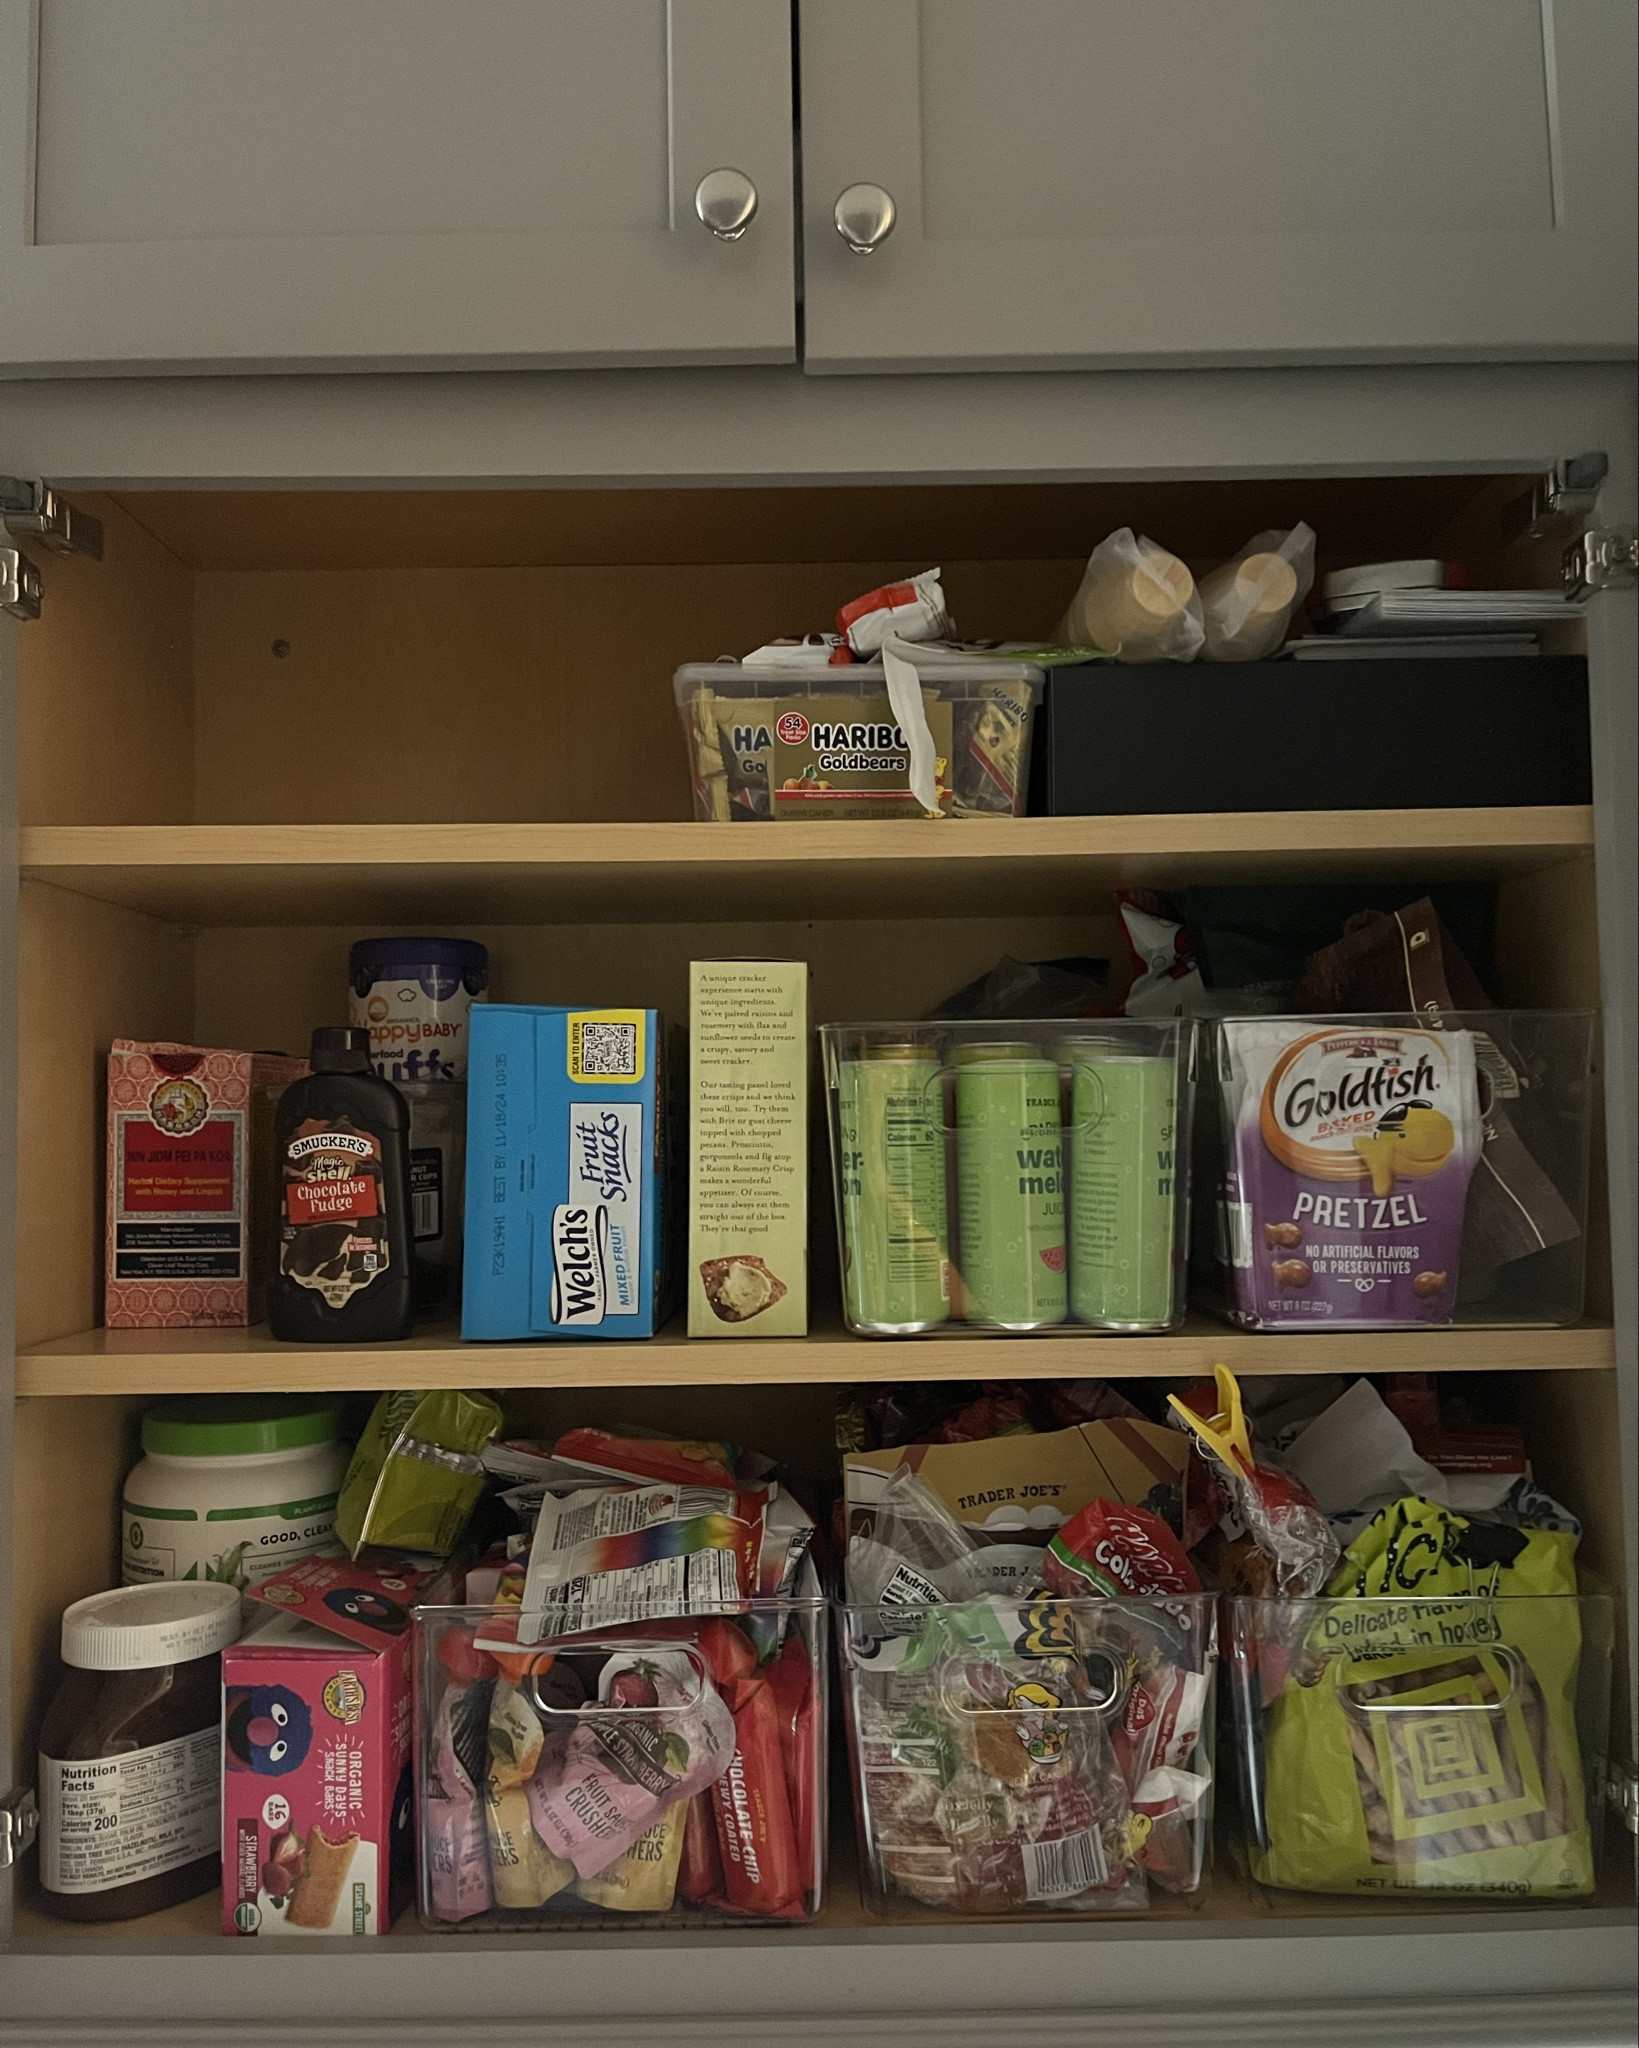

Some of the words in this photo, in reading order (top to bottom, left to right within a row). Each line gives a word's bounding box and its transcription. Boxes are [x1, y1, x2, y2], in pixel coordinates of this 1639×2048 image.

[785, 717, 801, 729] 54
[820, 755, 905, 770] Goldbears
[709, 976, 736, 984] unique
[738, 974, 766, 982] cracker
[700, 987, 742, 995] experience
[700, 999, 728, 1007] unique
[700, 1009, 722, 1017] We've
[724, 1010, 749, 1019] paired
[423, 1023, 459, 1037] BABY
[700, 1023, 736, 1031] rosemary
[700, 1033, 738, 1041] sunflower
[740, 1033, 761, 1041] seeds
[571, 1045, 578, 1054] TO
[759, 1045, 775, 1053] and
[494, 1053, 507, 1087] 10:35
[571, 1056, 579, 1074] SCAN
[1284, 1053, 1435, 1129] Goldfish
[493, 1093, 507, 1147] 11/18/24
[887, 1133, 917, 1141] Calories
[292, 1136, 367, 1156] SMUCKER'S
[576, 1122, 605, 1183] Fruit
[310, 1155, 344, 1171] Magic
[493, 1155, 506, 1169] BY
[597, 1111, 627, 1202] Snacks
[155, 1178, 183, 1186] Dietary
[297, 1180, 366, 1201] Chocolate
[493, 1176, 506, 1203] BEST
[310, 1197, 353, 1213] Fudge
[1292, 1191, 1429, 1230] PRETZEL
[609, 1223, 624, 1262] FRUIT
[1305, 1244, 1319, 1259] NO
[1322, 1244, 1374, 1260] ARTIFICIAL
[1376, 1245, 1420, 1260] FLAVORS
[558, 1209, 596, 1319] Welch's
[1312, 1260, 1327, 1274] OR
[1330, 1260, 1412, 1275] PRESERVATIVES
[614, 1264, 630, 1306] MIXED
[957, 1487, 1017, 1509] TRADER
[1020, 1485, 1062, 1499] JOE'S
[260, 1531, 301, 1546] GOOD,
[571, 1577, 584, 1596] 120
[1325, 1605, 1408, 1639] Delicate
[1411, 1628, 1433, 1646] in
[1136, 1697, 1147, 1722] Das
[61, 1765, 117, 1779] Nutrition
[613, 1736, 670, 1793] STRAWBERRY
[61, 1780, 95, 1791] Facts
[581, 1772, 611, 1807] FRUIT
[86, 1807, 106, 1816] (37g)
[274, 1803, 286, 1820] 16
[61, 1819, 92, 1827] Calories
[94, 1815, 118, 1831] 200
[724, 1813, 741, 1863] COATED
[245, 1835, 258, 1893] STRAWBERRY
[741, 1846, 761, 1885] CHIP
[1356, 1878, 1388, 1889] NET
[354, 1884, 363, 1910] SESAME
